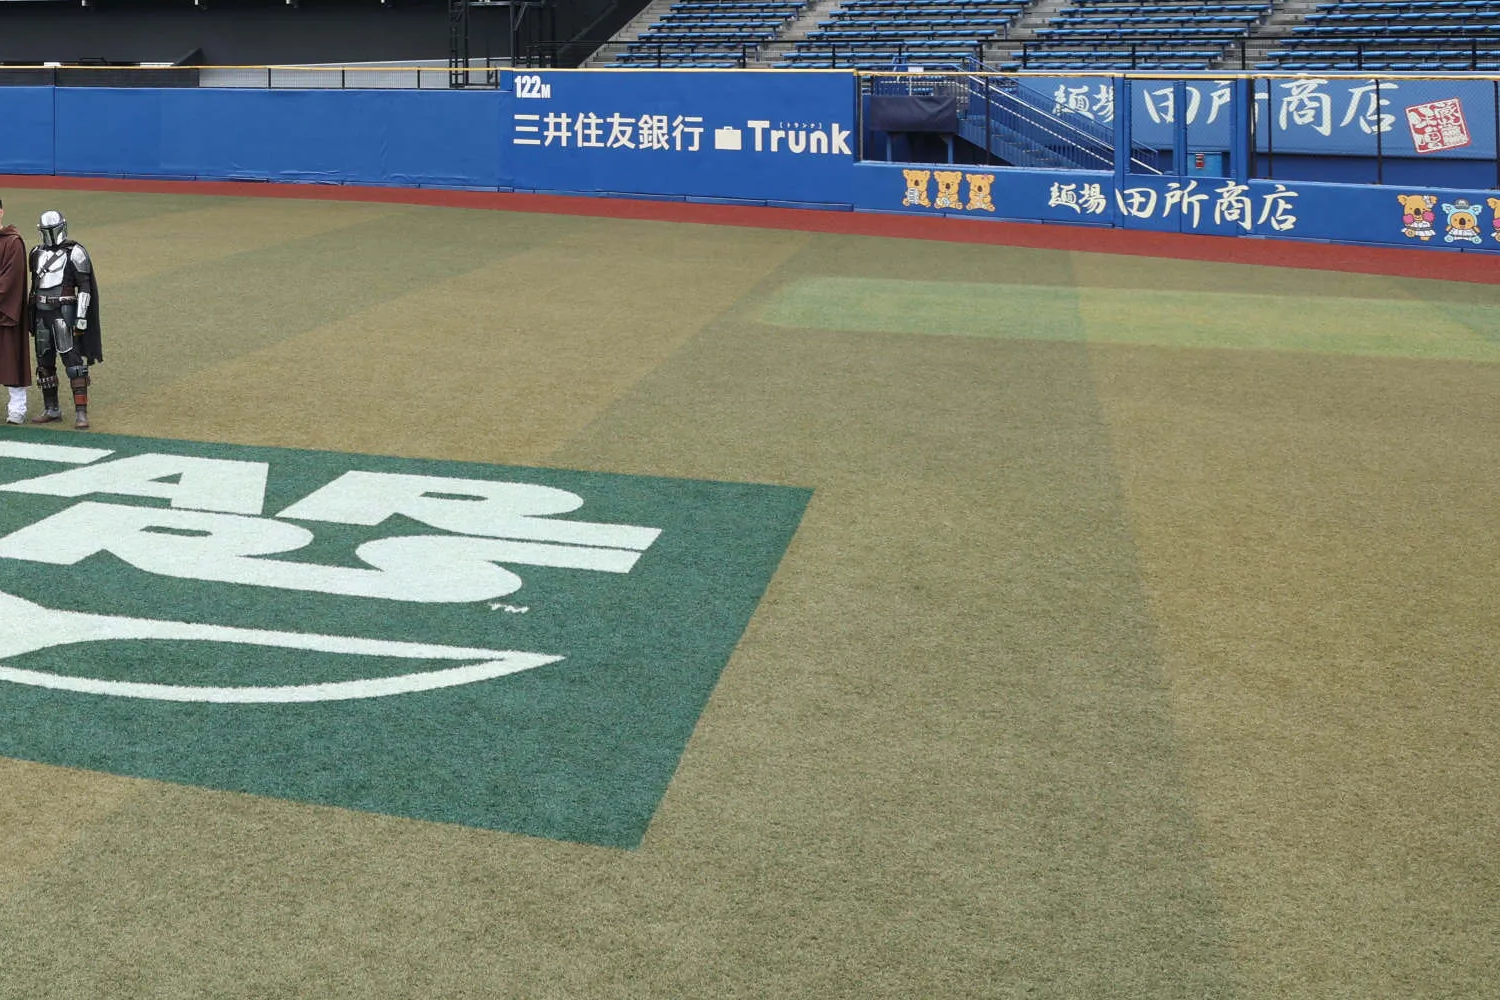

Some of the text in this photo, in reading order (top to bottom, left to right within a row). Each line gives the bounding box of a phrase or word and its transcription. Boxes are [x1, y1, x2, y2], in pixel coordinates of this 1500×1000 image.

[513, 112, 852, 155] 三井住友銀行 Trunk
[1115, 179, 1299, 232] 田所商店
